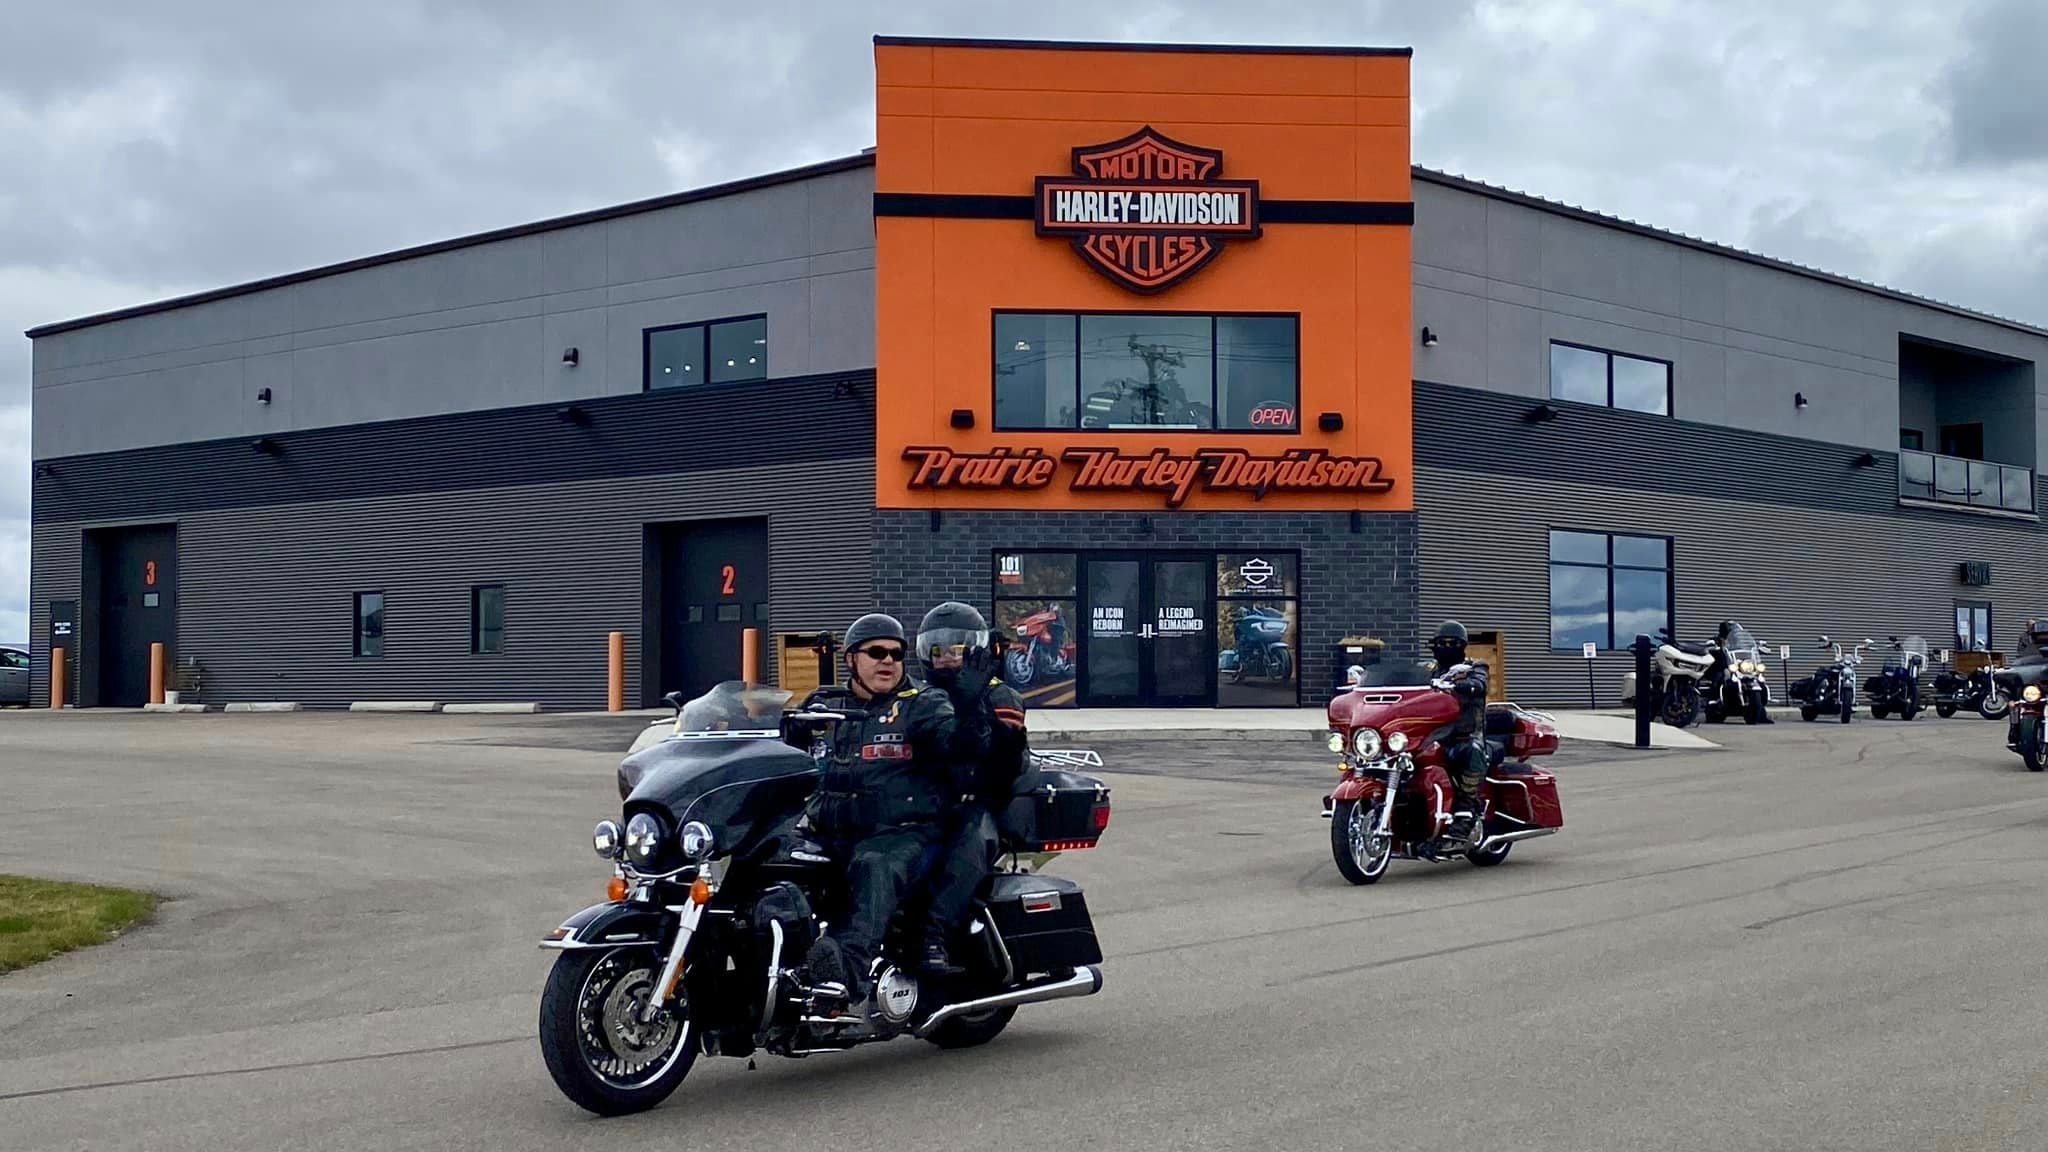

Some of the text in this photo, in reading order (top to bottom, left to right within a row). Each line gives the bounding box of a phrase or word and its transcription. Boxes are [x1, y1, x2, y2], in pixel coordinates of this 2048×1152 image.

[1100, 146, 1196, 180] MOTOR
[1056, 190, 1239, 225] HARLEY-DAVIDSON
[1100, 234, 1197, 278] CYCLES
[1251, 408, 1294, 425] OPEN
[904, 447, 1393, 505] Prairie Harley-Davidson
[1000, 556, 1020, 571] 101
[146, 560, 155, 585] 3
[722, 565, 735, 594] 2
[1093, 608, 1124, 619] AN ICON
[1158, 608, 1194, 619] A LEGEND
[1093, 619, 1123, 630] REBORN
[1158, 619, 1204, 630] REIMAGINED
[892, 989, 910, 999] 103
